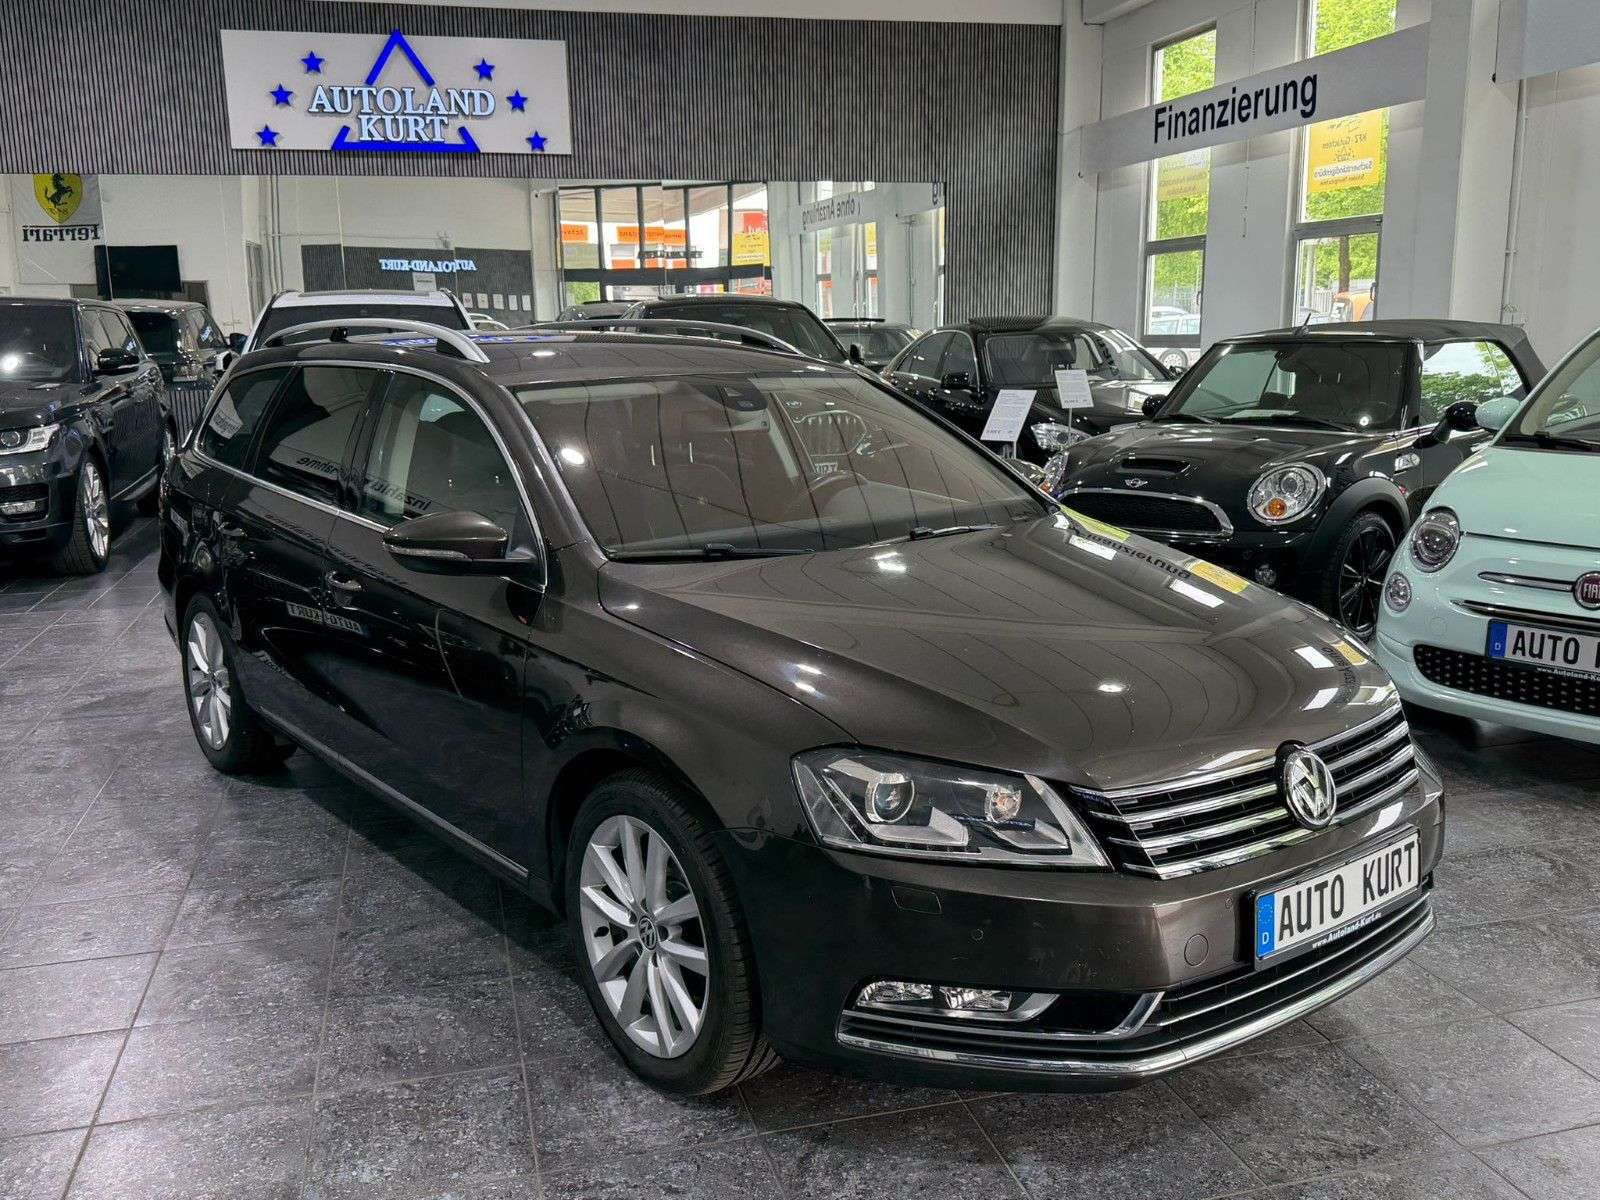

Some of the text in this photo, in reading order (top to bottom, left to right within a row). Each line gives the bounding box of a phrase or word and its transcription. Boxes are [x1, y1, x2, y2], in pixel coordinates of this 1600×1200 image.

[308, 85, 496, 117] AUTOLAND
[1154, 74, 1318, 143] Finanzierung
[358, 114, 449, 142] KURT
[1512, 630, 1580, 665] AUTO
[1278, 874, 1344, 942] AUTO
[1363, 841, 1415, 905] KURT
